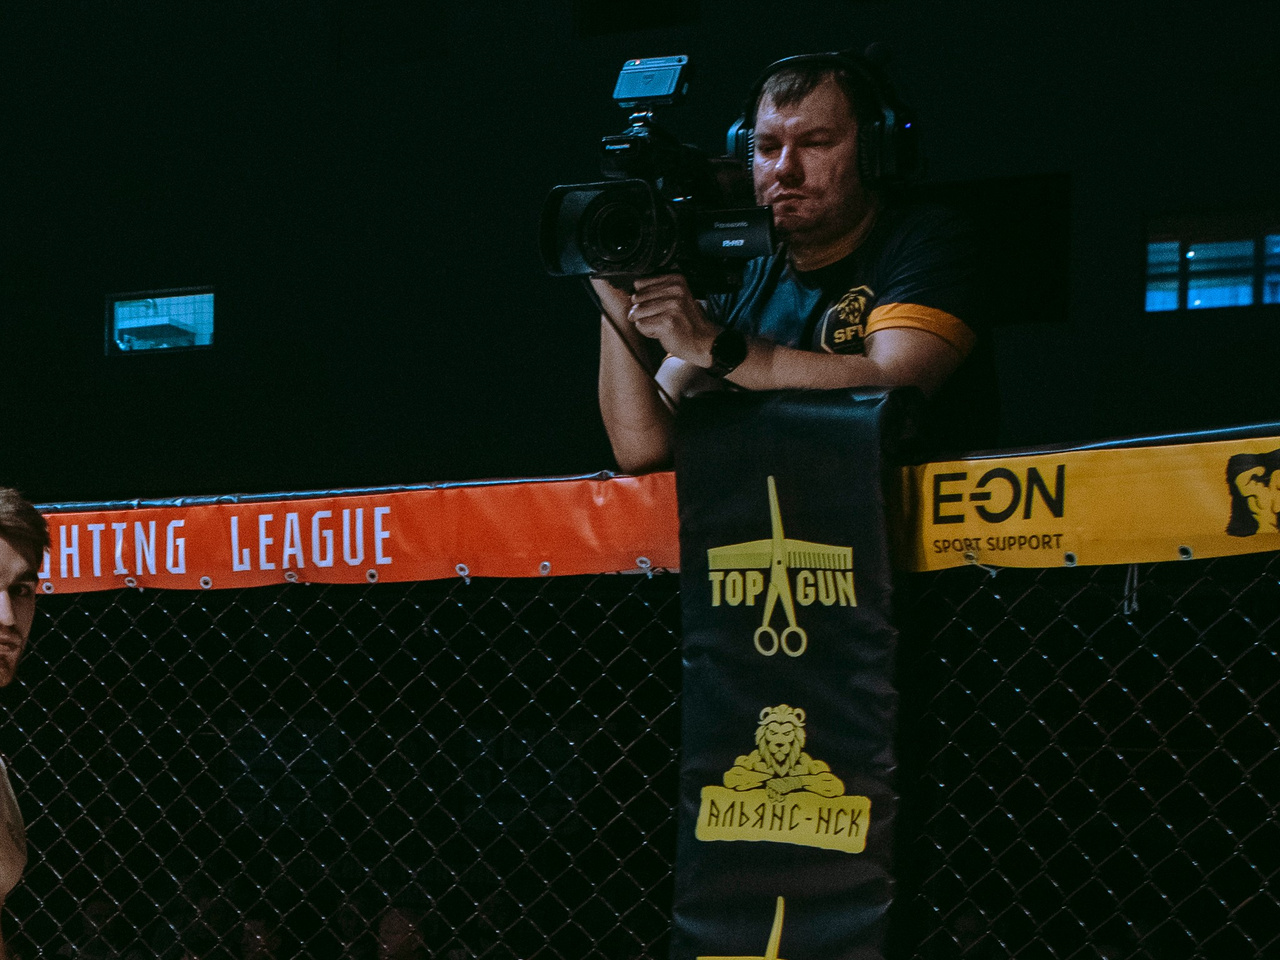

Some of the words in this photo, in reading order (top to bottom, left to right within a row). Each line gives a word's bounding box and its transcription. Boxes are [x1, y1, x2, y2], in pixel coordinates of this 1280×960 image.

[230, 506, 393, 572] LEAGUE
[933, 537, 982, 553] SPORT
[986, 534, 1064, 551] SUPPORT
[708, 570, 764, 607] TOP
[796, 570, 858, 608] GUN
[707, 799, 863, 837] АЛЬЯНС-НСК
